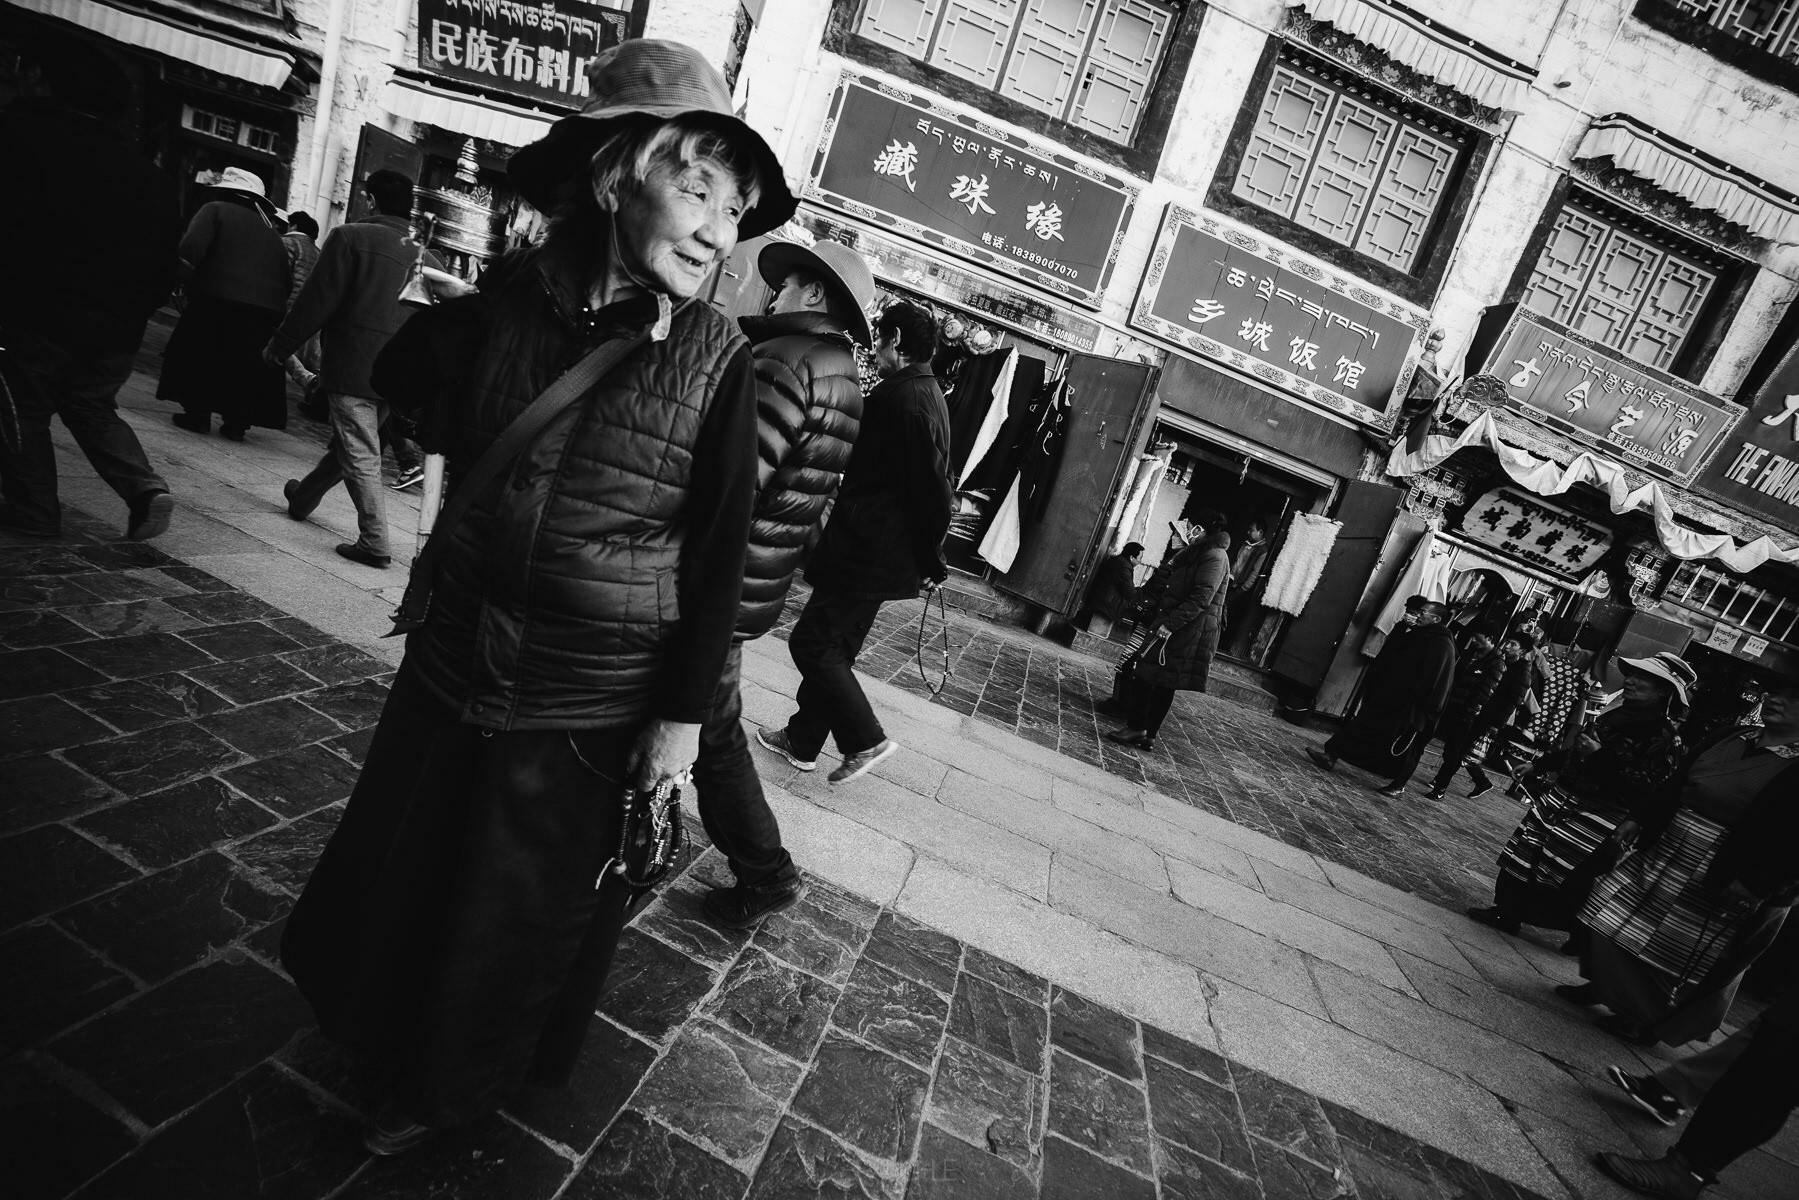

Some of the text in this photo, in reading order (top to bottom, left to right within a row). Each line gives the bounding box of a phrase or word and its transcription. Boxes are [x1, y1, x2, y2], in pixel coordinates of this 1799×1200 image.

[873, 138, 1065, 244] 藏珠缘
[1188, 298, 1367, 390] 乡城饭馆
[1508, 357, 1699, 459] 古今艺源
[1724, 441, 1799, 508] THE FINAN
